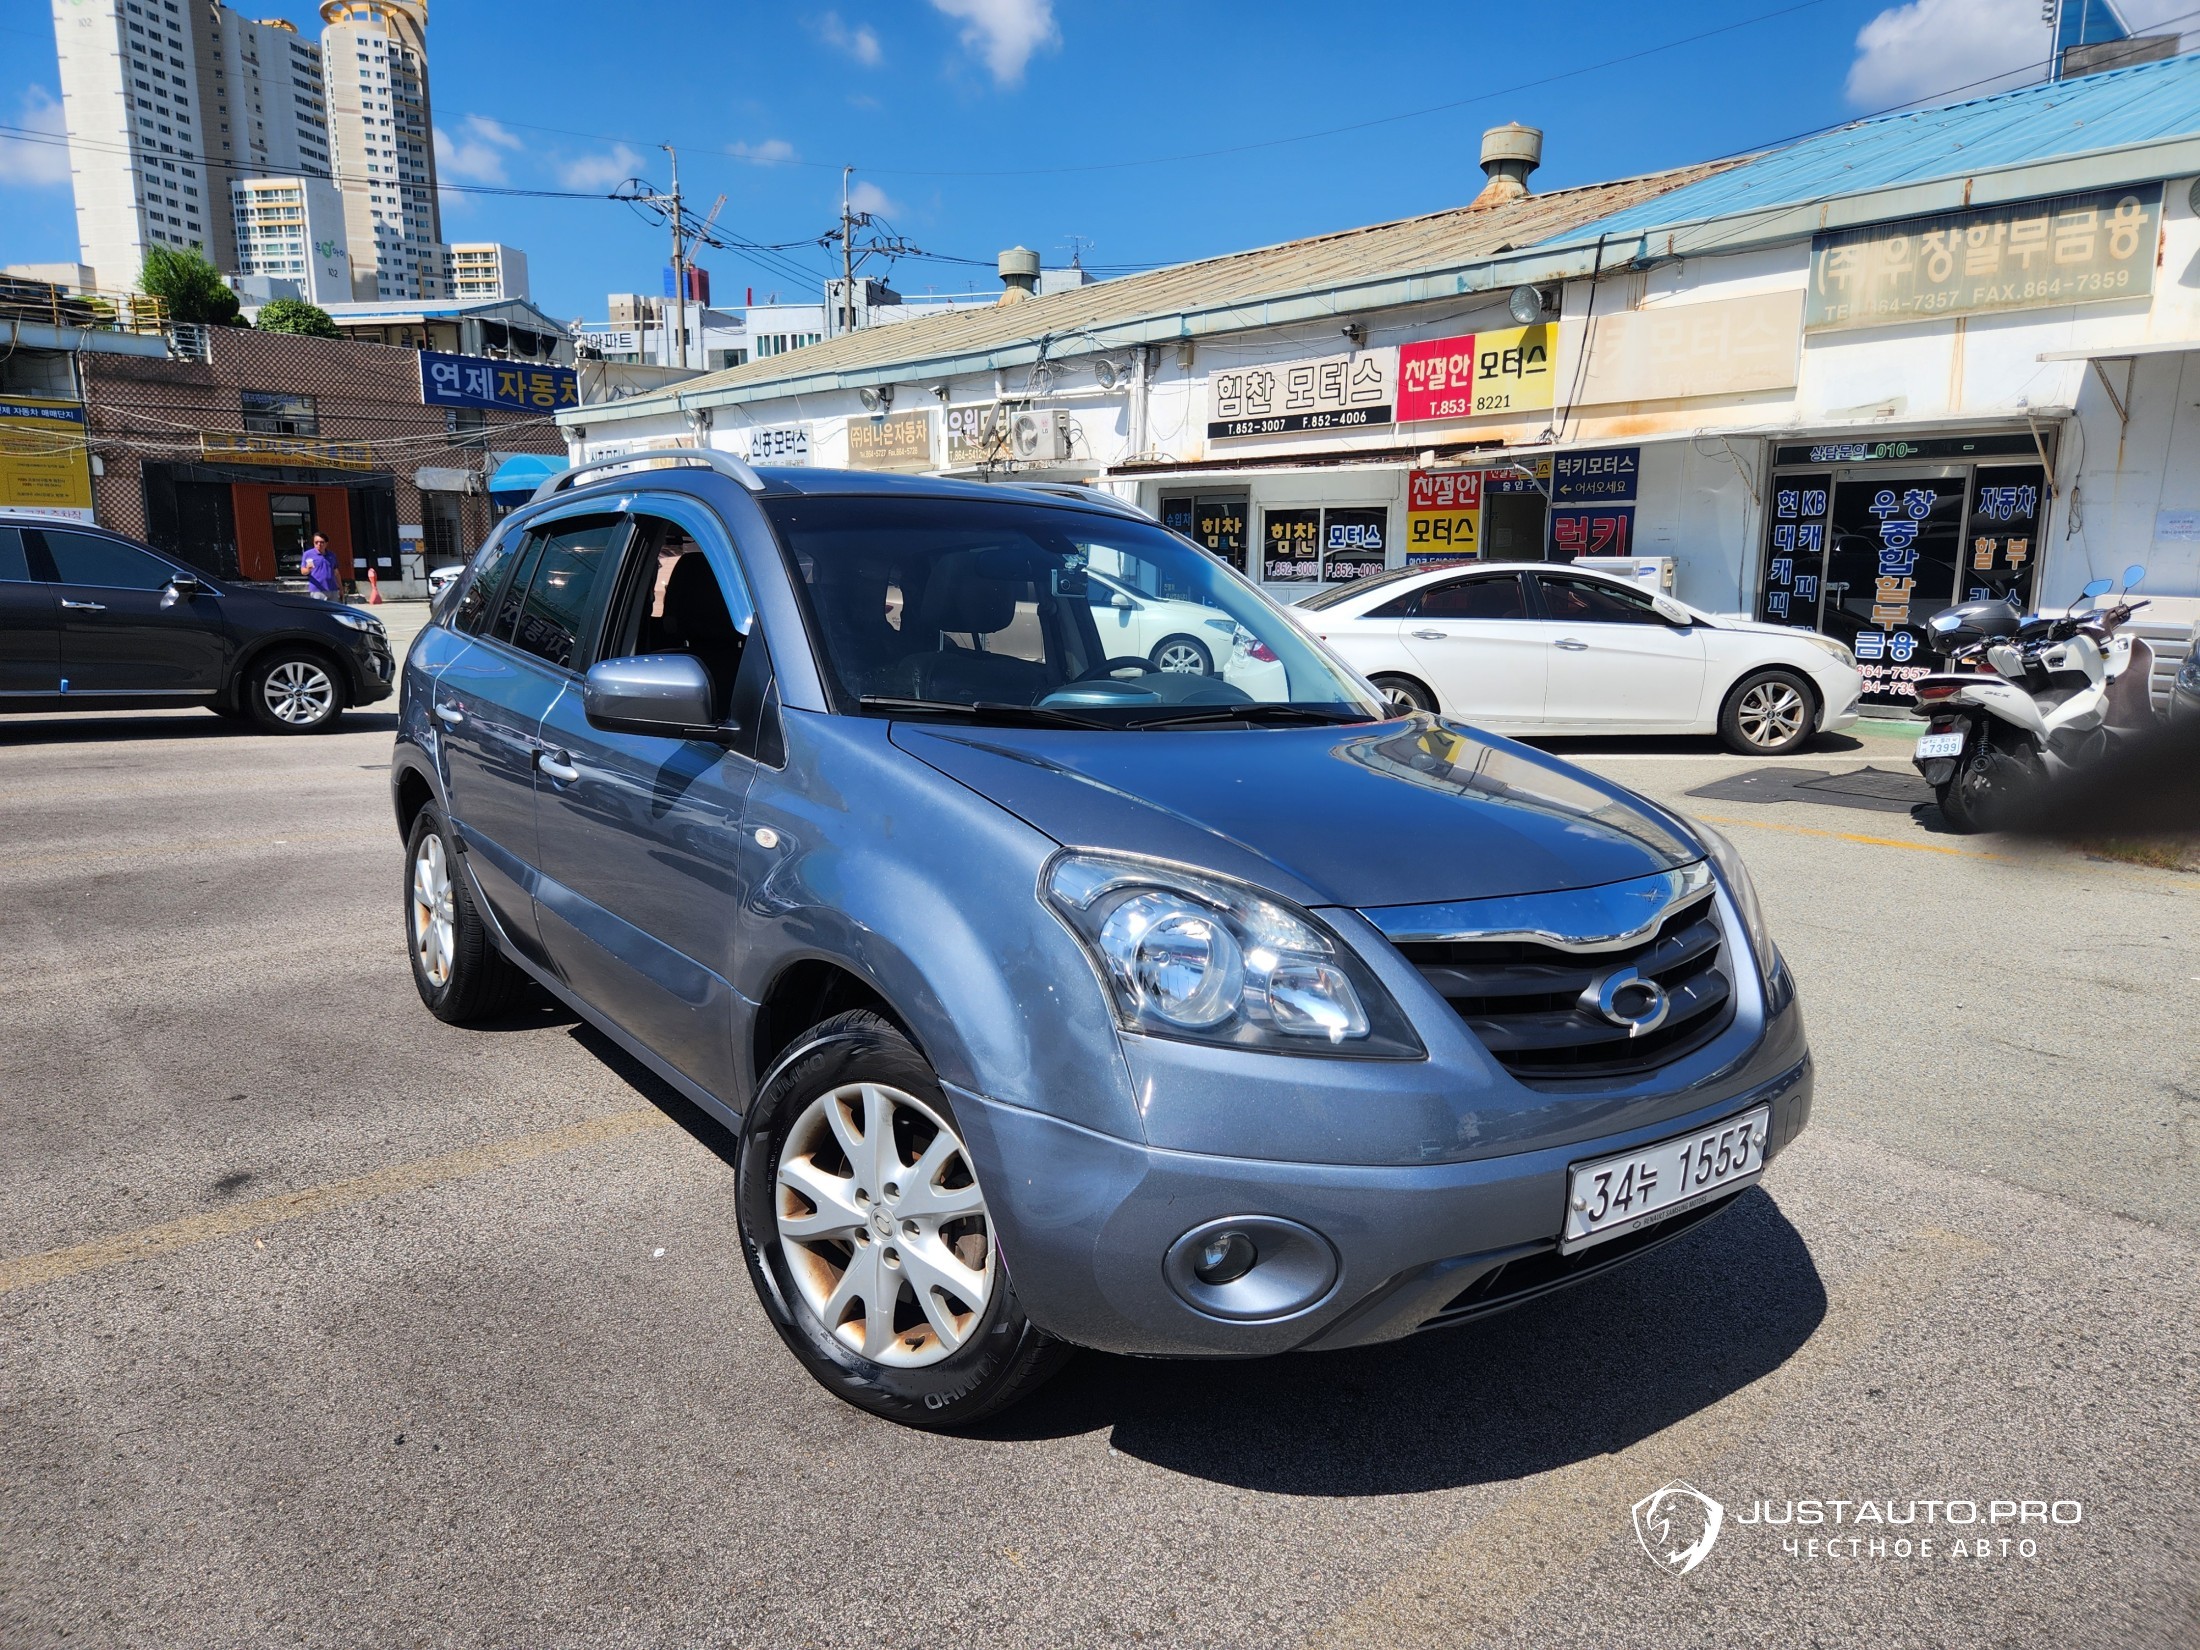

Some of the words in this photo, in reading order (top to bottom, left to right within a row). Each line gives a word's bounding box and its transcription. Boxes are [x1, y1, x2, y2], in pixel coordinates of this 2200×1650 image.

[1973, 269, 2129, 304] FAX.864-7359
[1405, 353, 1471, 392] 친절한
[1478, 345, 1547, 379] 모터스
[1217, 372, 1275, 418] 힘찬
[1286, 358, 1382, 409] 모터스
[1477, 394, 1511, 410] 8221
[13, 407, 39, 416] 자동차
[41, 410, 74, 419] 매매단지
[948, 408, 979, 448] 우원
[1228, 419, 1286, 435] T.852-3007
[1302, 411, 1367, 428] F.852-4006
[752, 431, 772, 458] 신흥
[775, 428, 808, 455] 모터스
[1809, 443, 1868, 462] 상담문의
[1413, 474, 1478, 506] 친절한
[1575, 481, 1627, 494] 어서오세요
[1869, 489, 1937, 520] 우창
[1979, 485, 2036, 521] 자동차
[1166, 512, 1191, 527] 수입차
[1201, 516, 1242, 548] 힘찬
[1412, 518, 1474, 546] 모터스
[1270, 522, 1317, 554] 힘찬
[1327, 525, 1383, 549] 모터스
[1555, 514, 1628, 558] 럭키
[1265, 561, 1319, 577] T.852-3007
[1325, 562, 1384, 579] F.852-4006
[1855, 631, 1918, 662] 금융
[1861, 680, 1917, 696] 64-735
[1929, 743, 1957, 753] 7399
[1588, 1161, 1658, 1222] 34누
[1679, 1122, 1753, 1192] 1553
[1643, 1212, 1665, 1226] RENAULT
[1665, 1204, 1689, 1217] SAMSUNG
[1689, 1196, 1707, 1209] MOTORS
